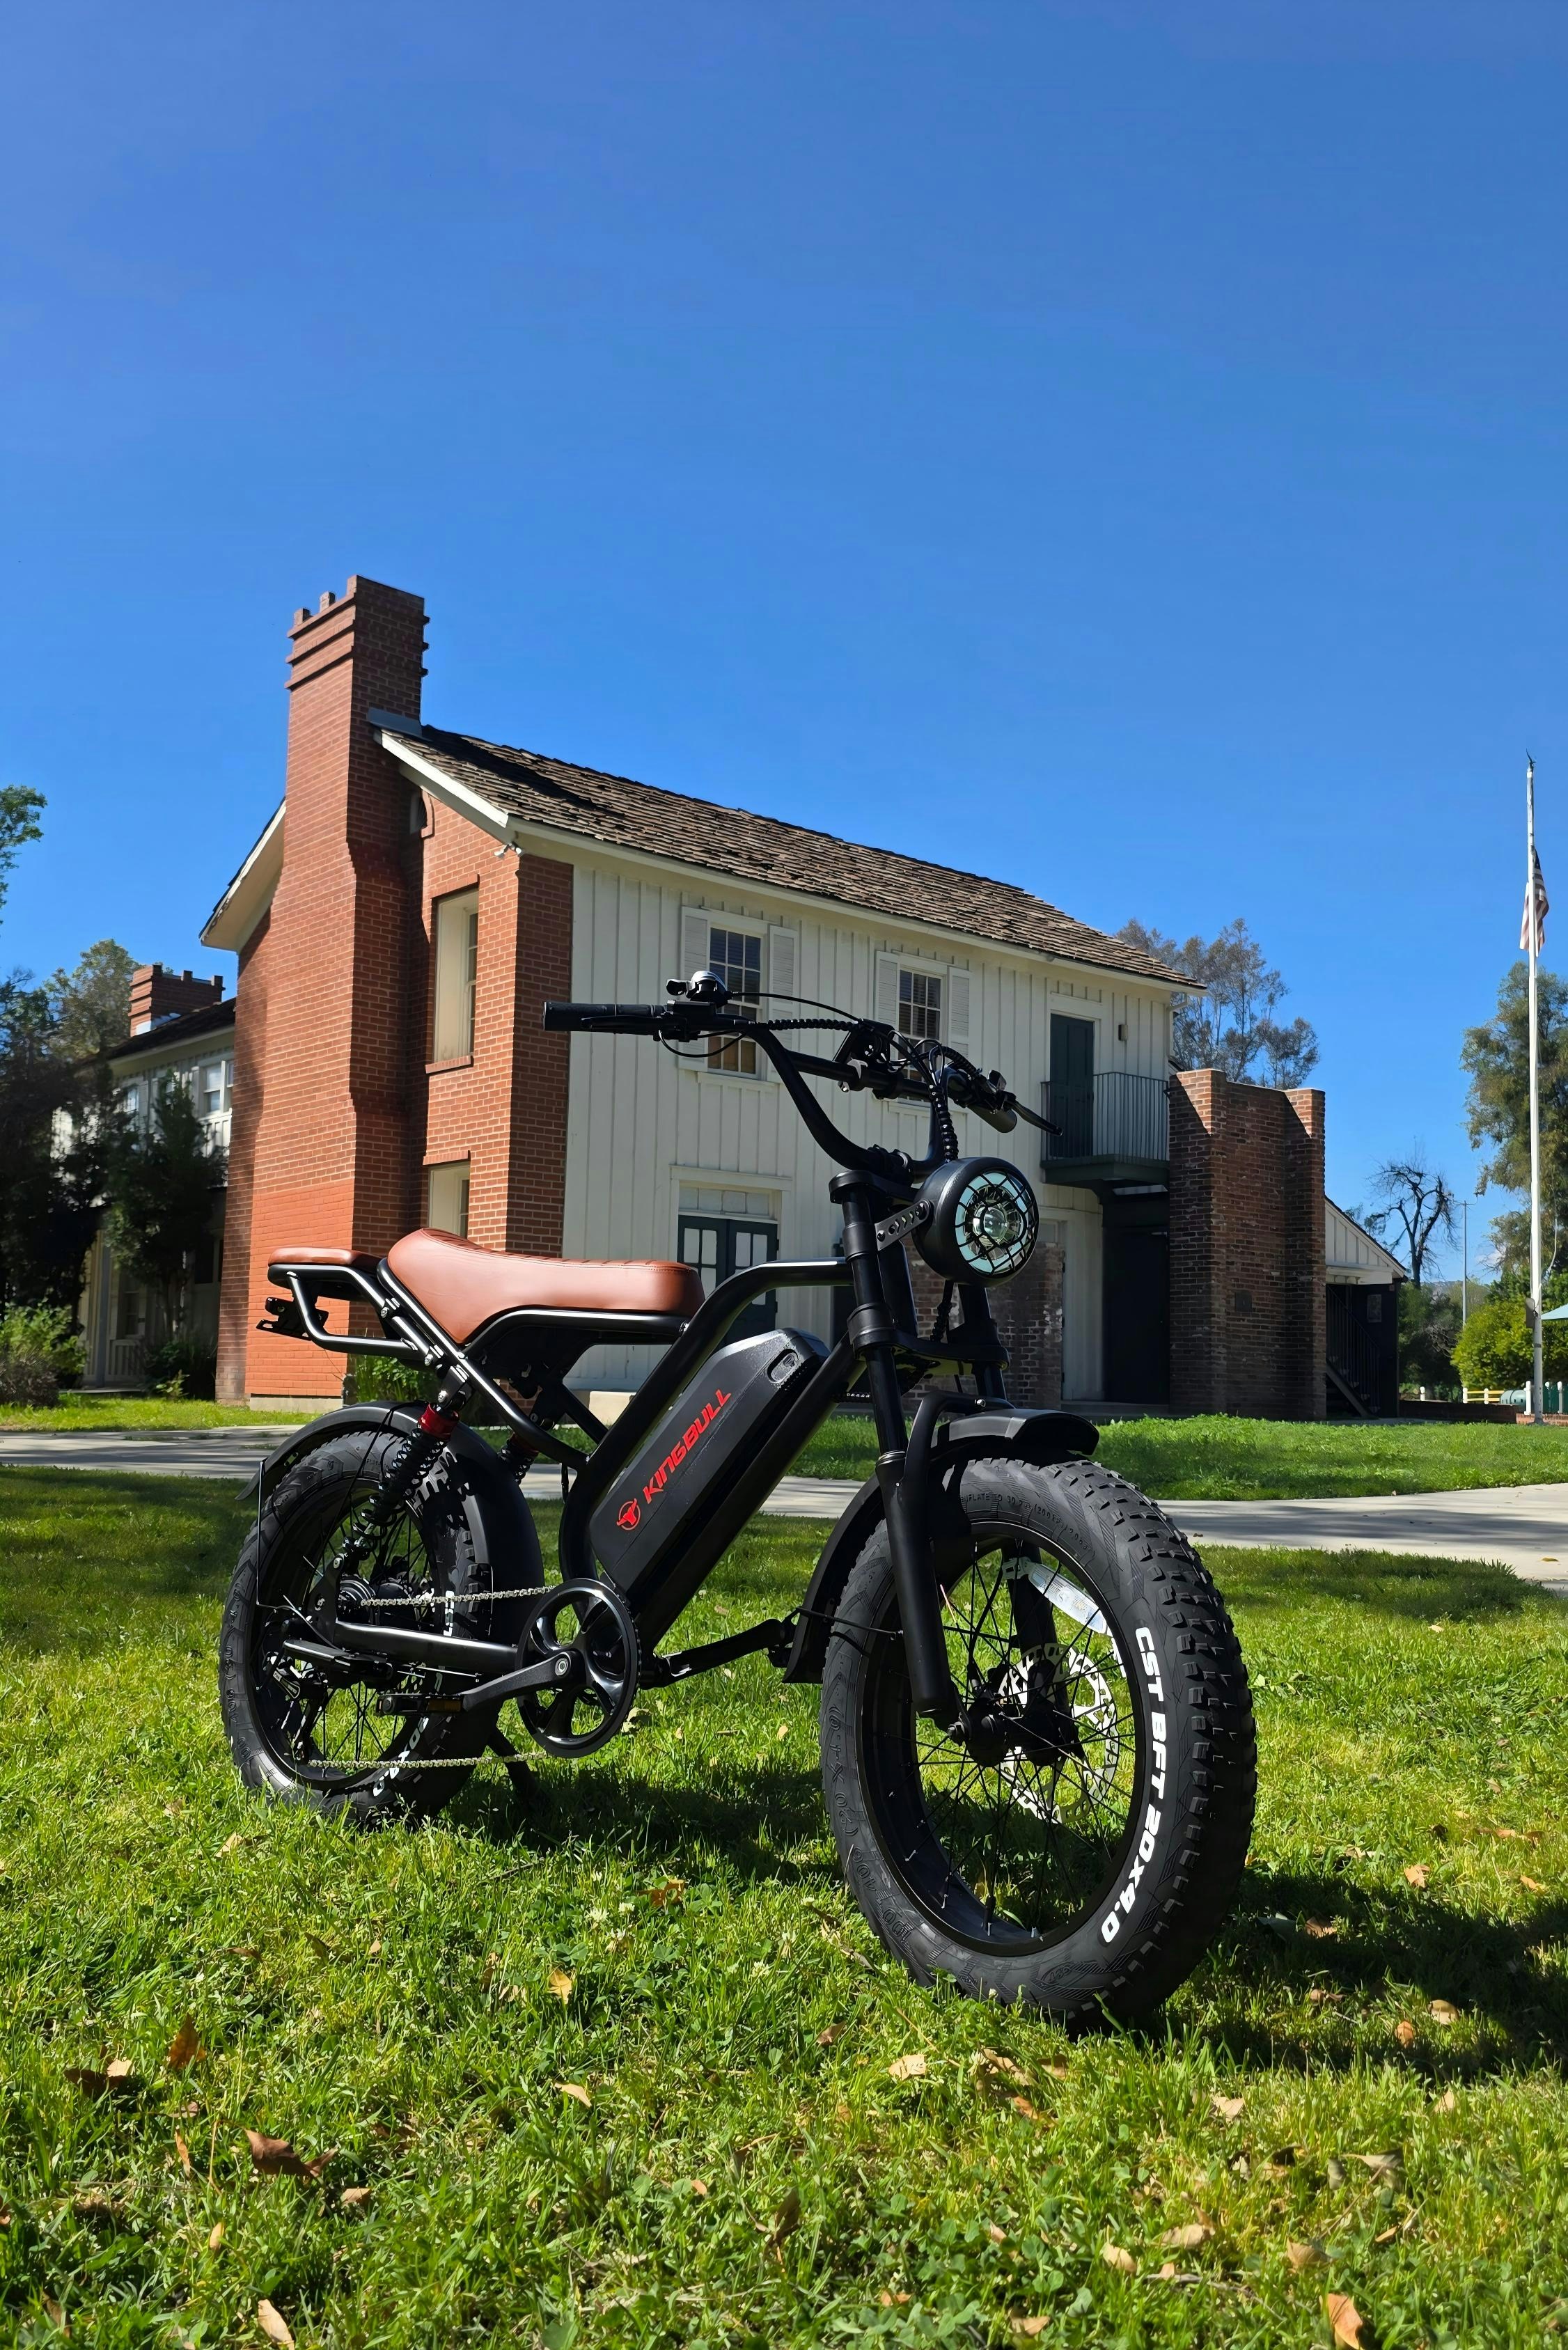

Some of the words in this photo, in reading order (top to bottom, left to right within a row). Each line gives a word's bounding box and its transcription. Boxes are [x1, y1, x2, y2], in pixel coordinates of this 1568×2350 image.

[643, 1388, 731, 1503] KINGBULL
[1136, 1627, 1164, 1702] CST
[1151, 1711, 1166, 1800] BFT
